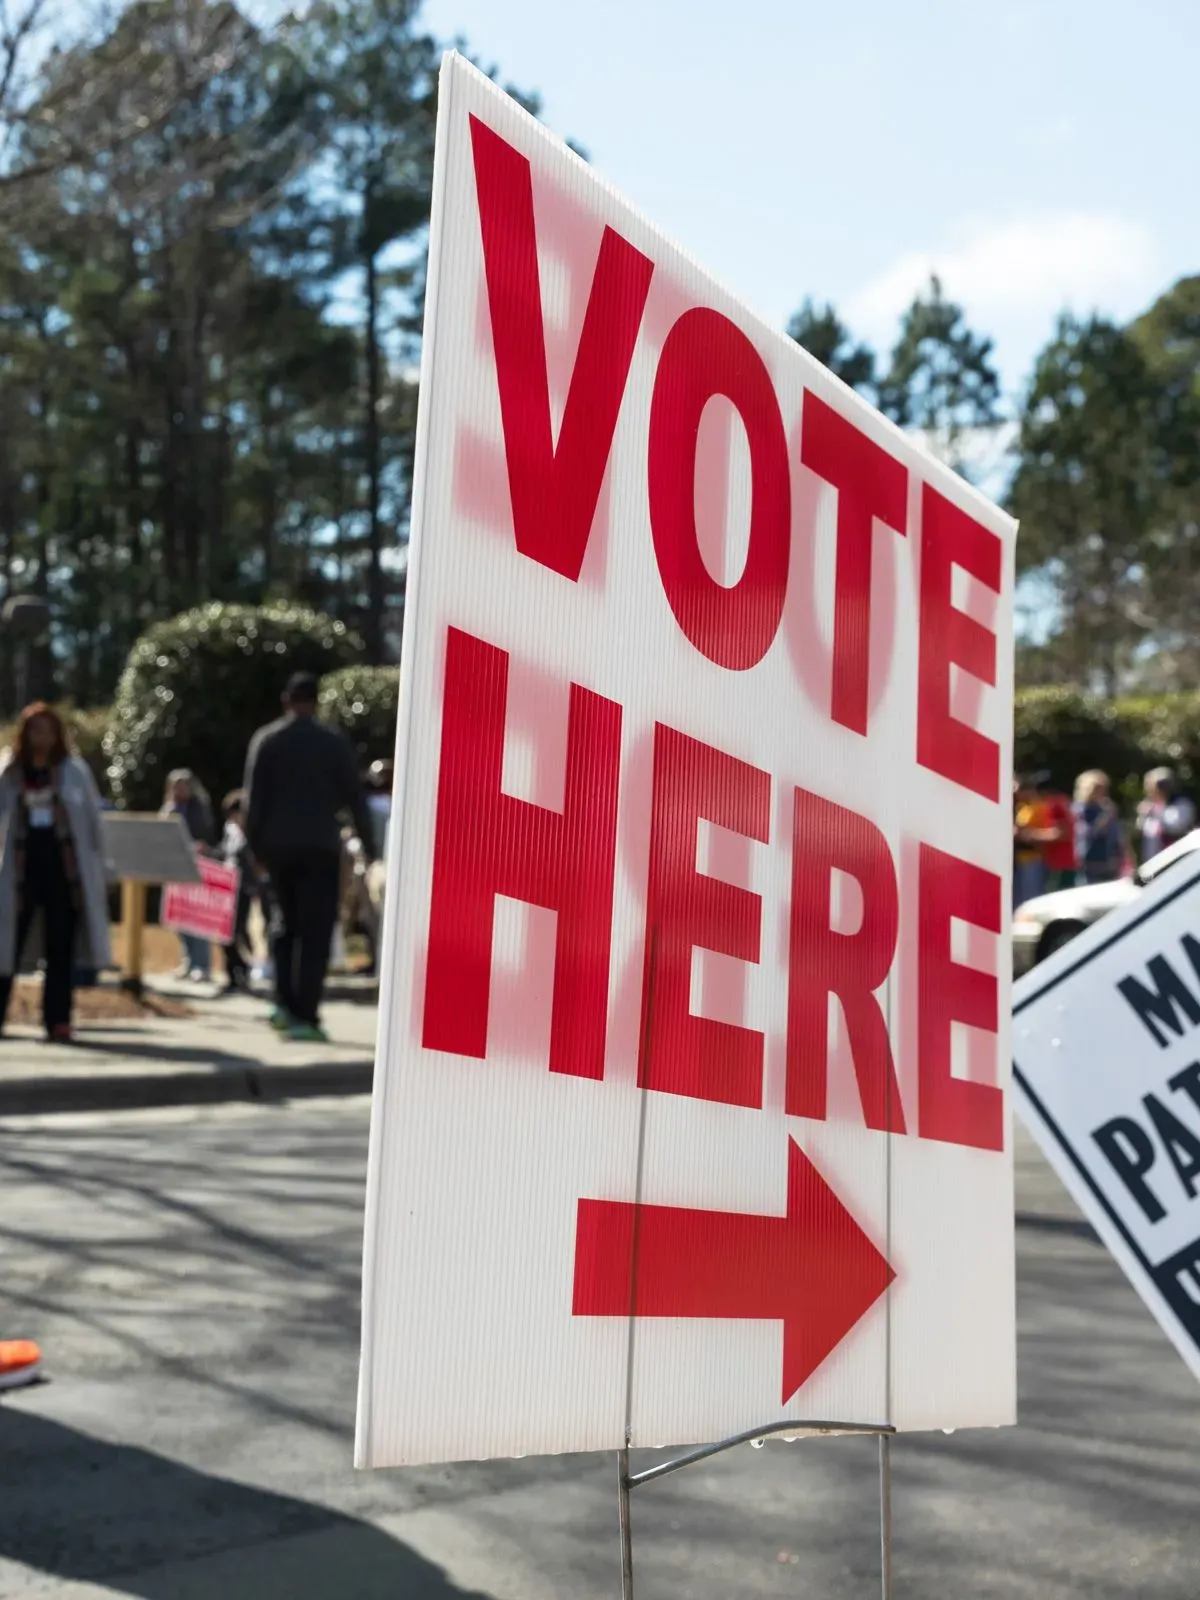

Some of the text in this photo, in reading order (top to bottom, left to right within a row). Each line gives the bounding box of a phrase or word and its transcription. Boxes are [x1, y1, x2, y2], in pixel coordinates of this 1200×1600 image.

[468, 111, 1002, 805] VOTE
[421, 624, 1004, 1153] HERE
[1116, 933, 1200, 1050] M
